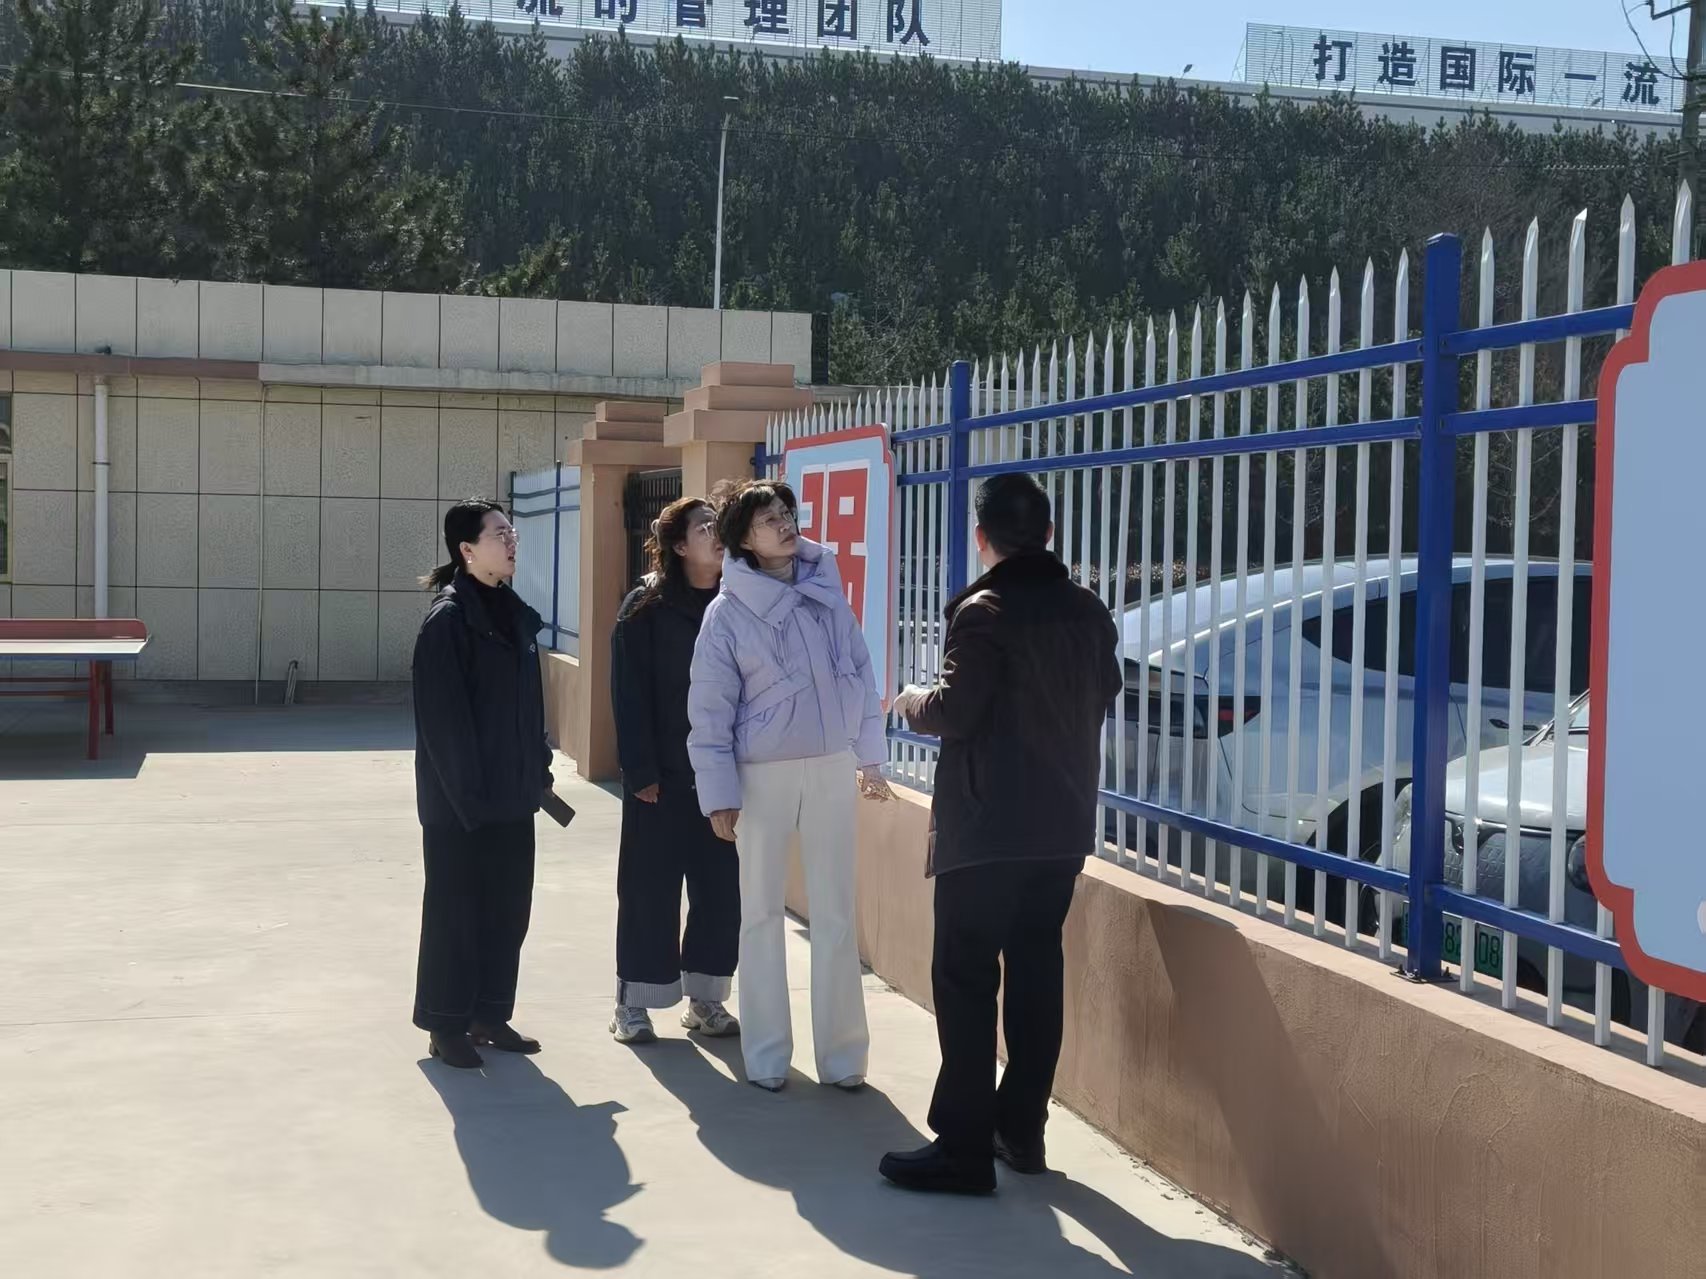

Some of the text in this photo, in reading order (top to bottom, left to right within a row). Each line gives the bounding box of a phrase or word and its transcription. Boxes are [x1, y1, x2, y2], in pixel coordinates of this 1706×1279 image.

[1313, 34, 1660, 105] 打造国际一流
